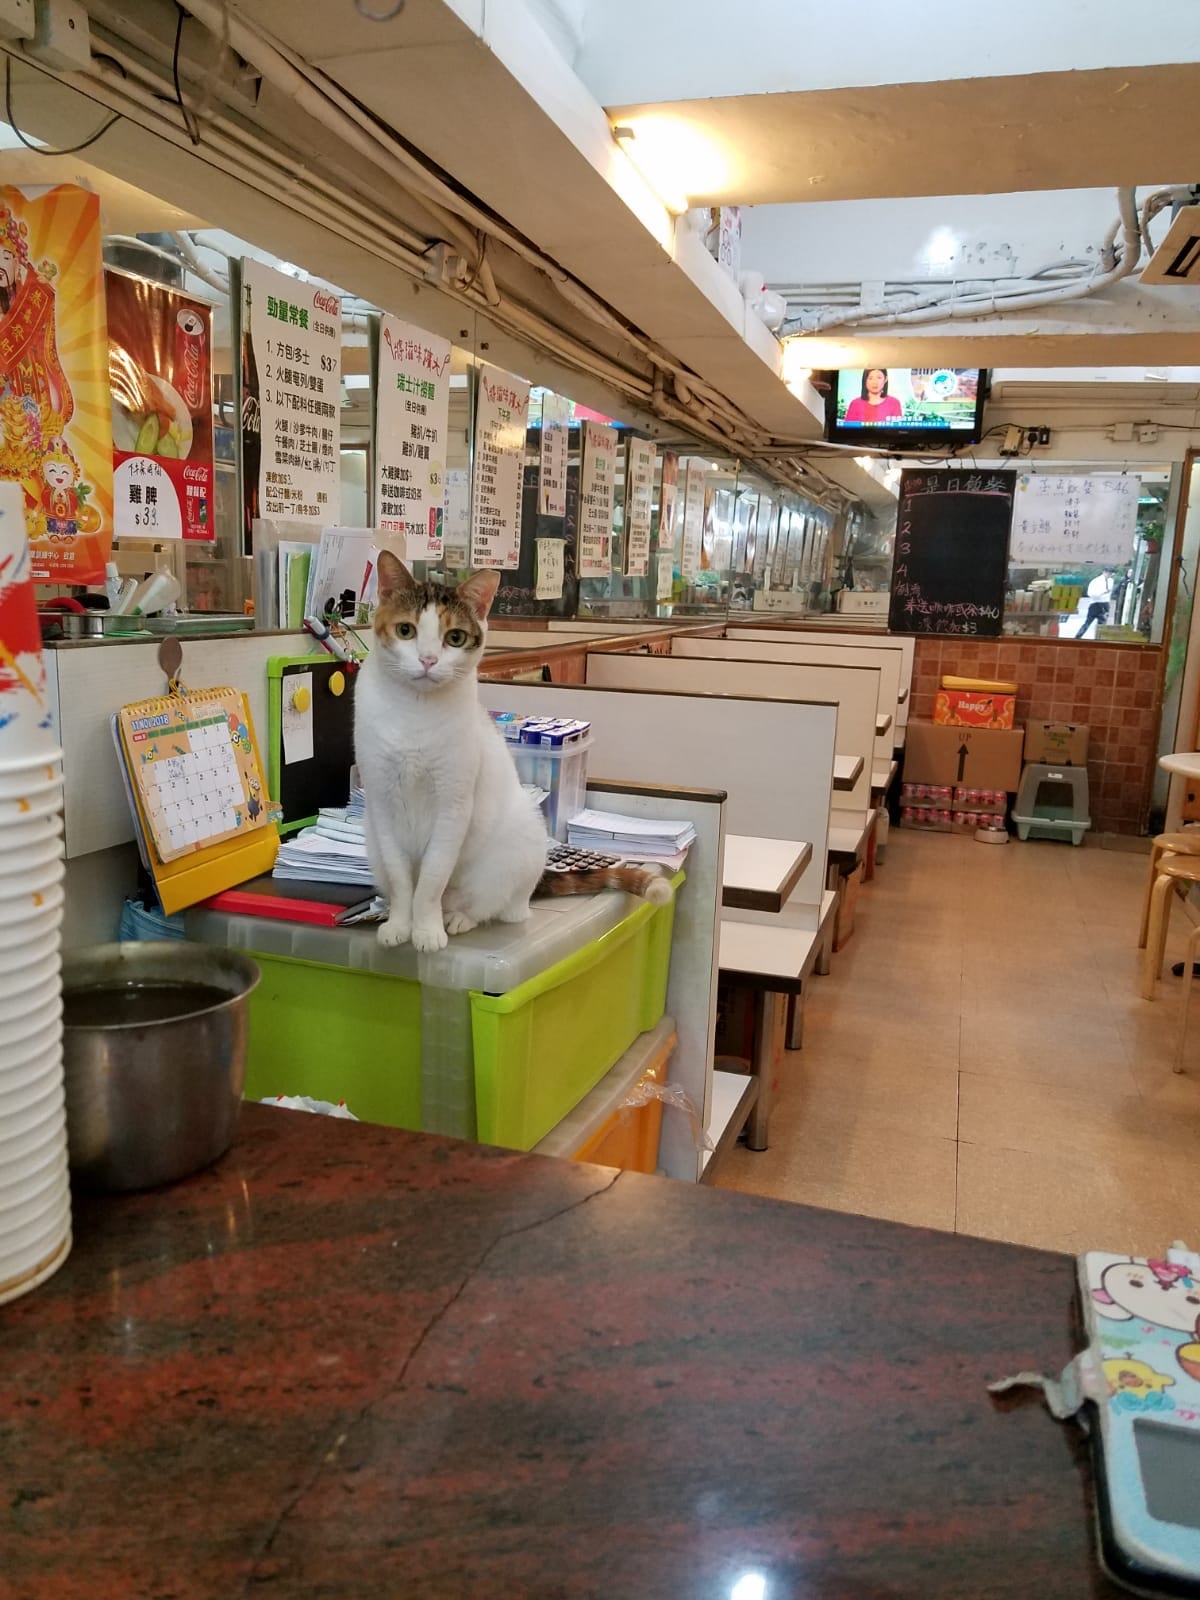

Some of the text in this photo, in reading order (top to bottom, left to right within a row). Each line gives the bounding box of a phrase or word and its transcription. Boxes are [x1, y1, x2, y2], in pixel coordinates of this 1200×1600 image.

[267, 295, 309, 330] 勁量常餐
[276, 341, 310, 365] 方包/多士
[320, 354, 337, 372] $37
[958, 700, 986, 713] Happy
[152, 714, 170, 728] 2018
